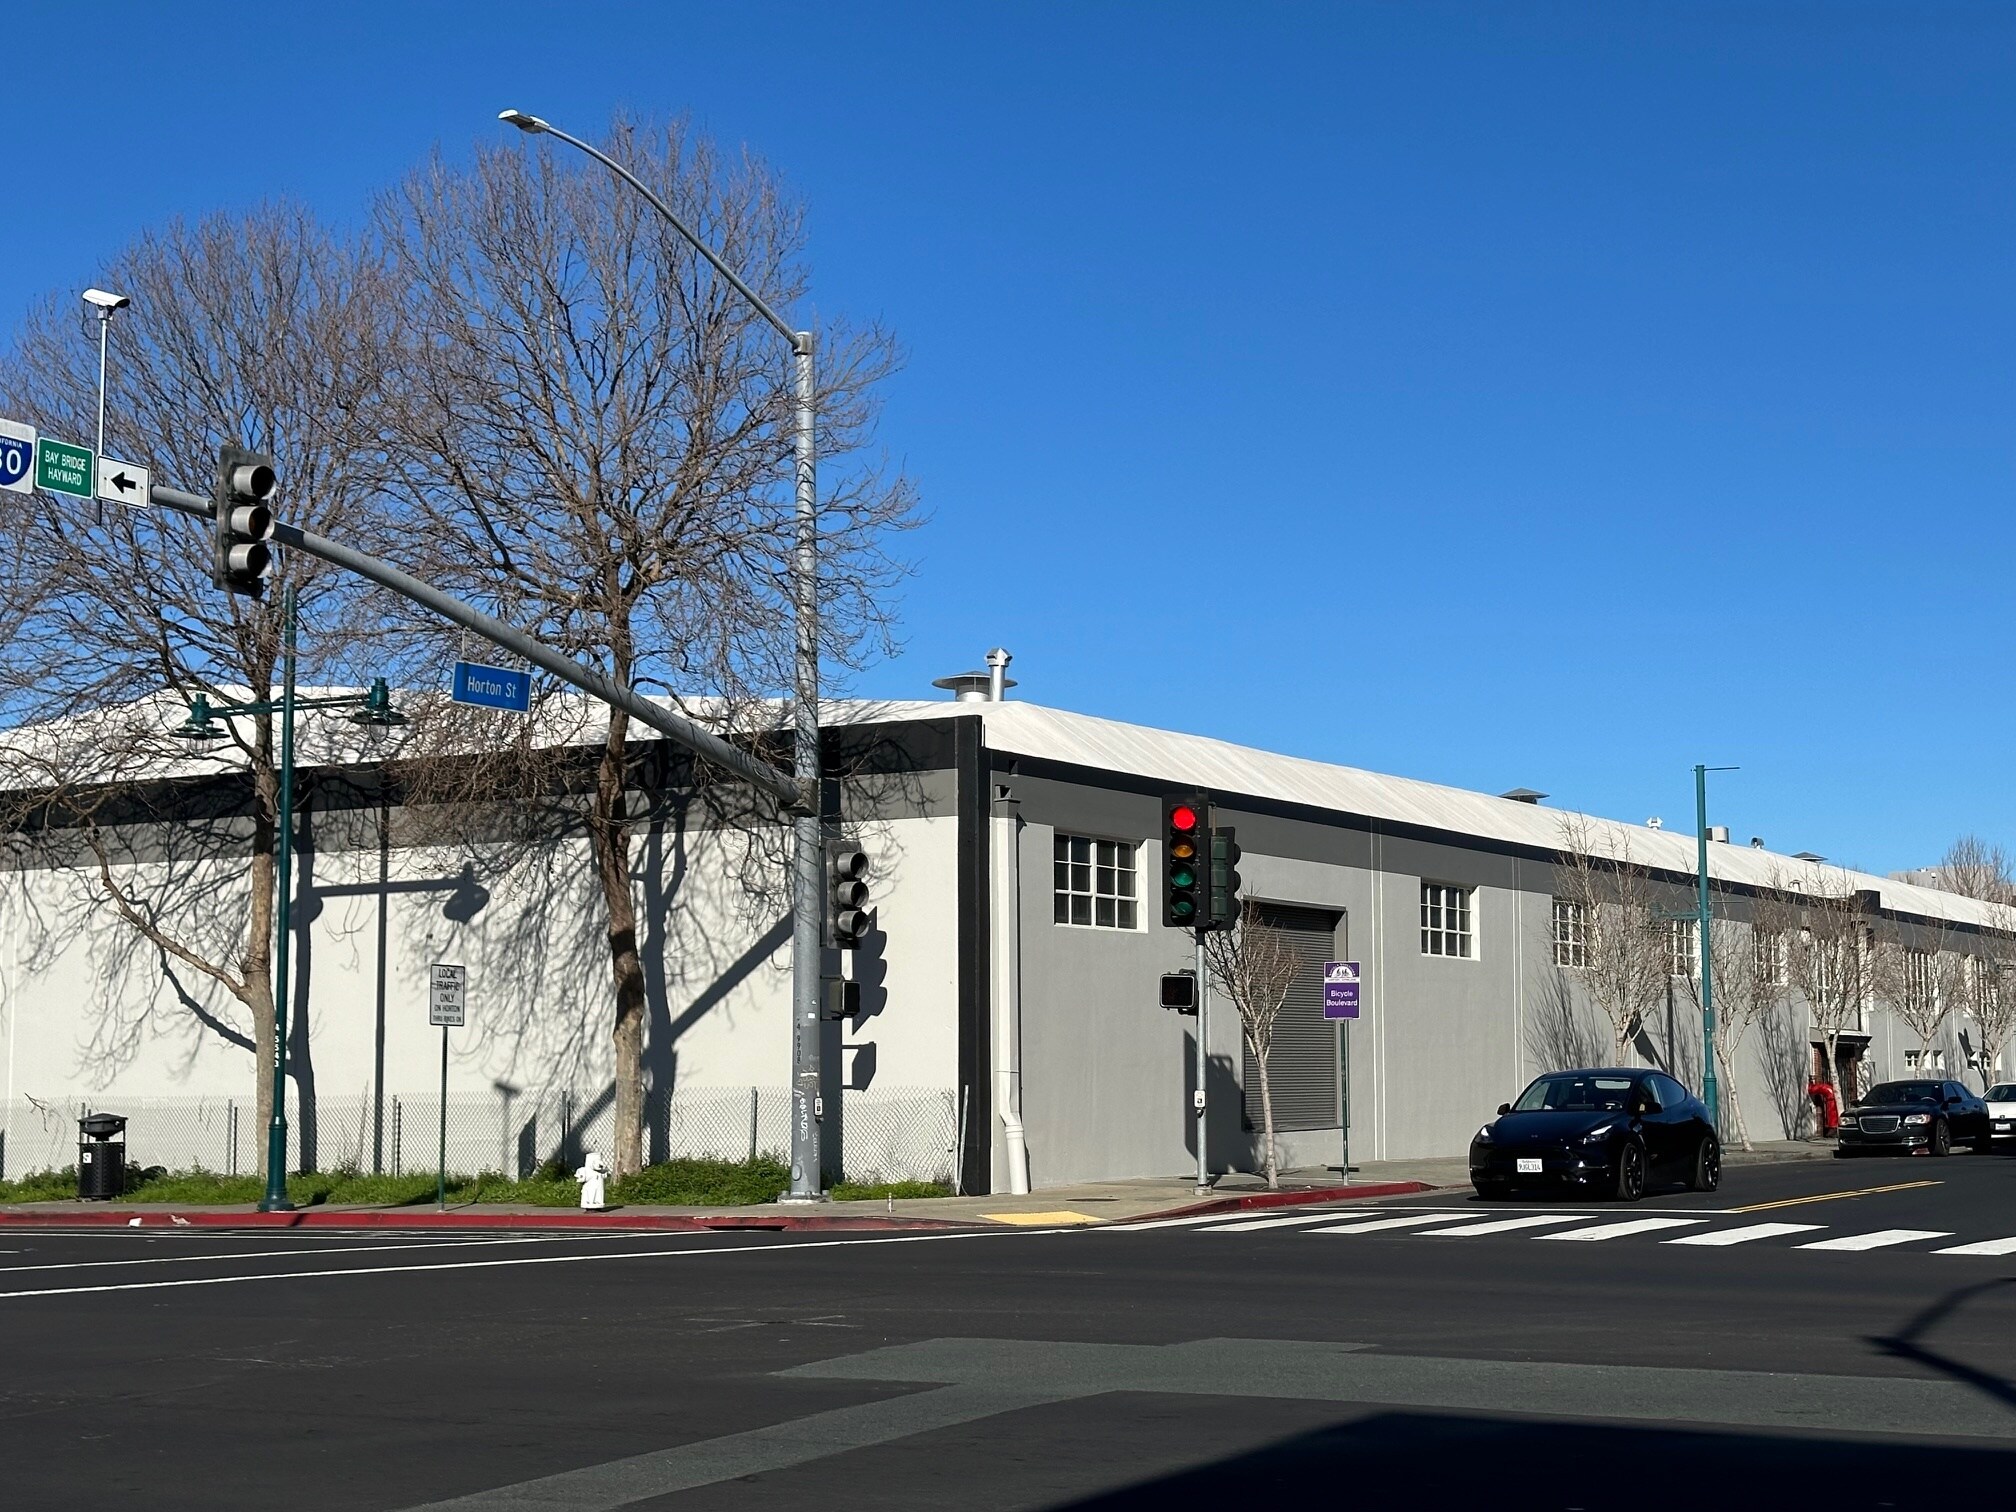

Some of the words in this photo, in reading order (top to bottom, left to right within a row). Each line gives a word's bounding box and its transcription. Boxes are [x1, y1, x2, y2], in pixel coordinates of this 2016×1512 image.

[0, 447, 22, 476] 0
[45, 449, 60, 463] BAY
[61, 454, 86, 471] BRIDGE
[48, 466, 82, 486] HAYWARD
[467, 675, 501, 696] Horton
[505, 682, 517, 698] St
[438, 967, 458, 979] LOCAL
[436, 980, 461, 991] TRAFFIC
[440, 992, 455, 1003] ONLY
[1330, 990, 1354, 999] Bicycle
[1326, 999, 1358, 1007] Boulevard
